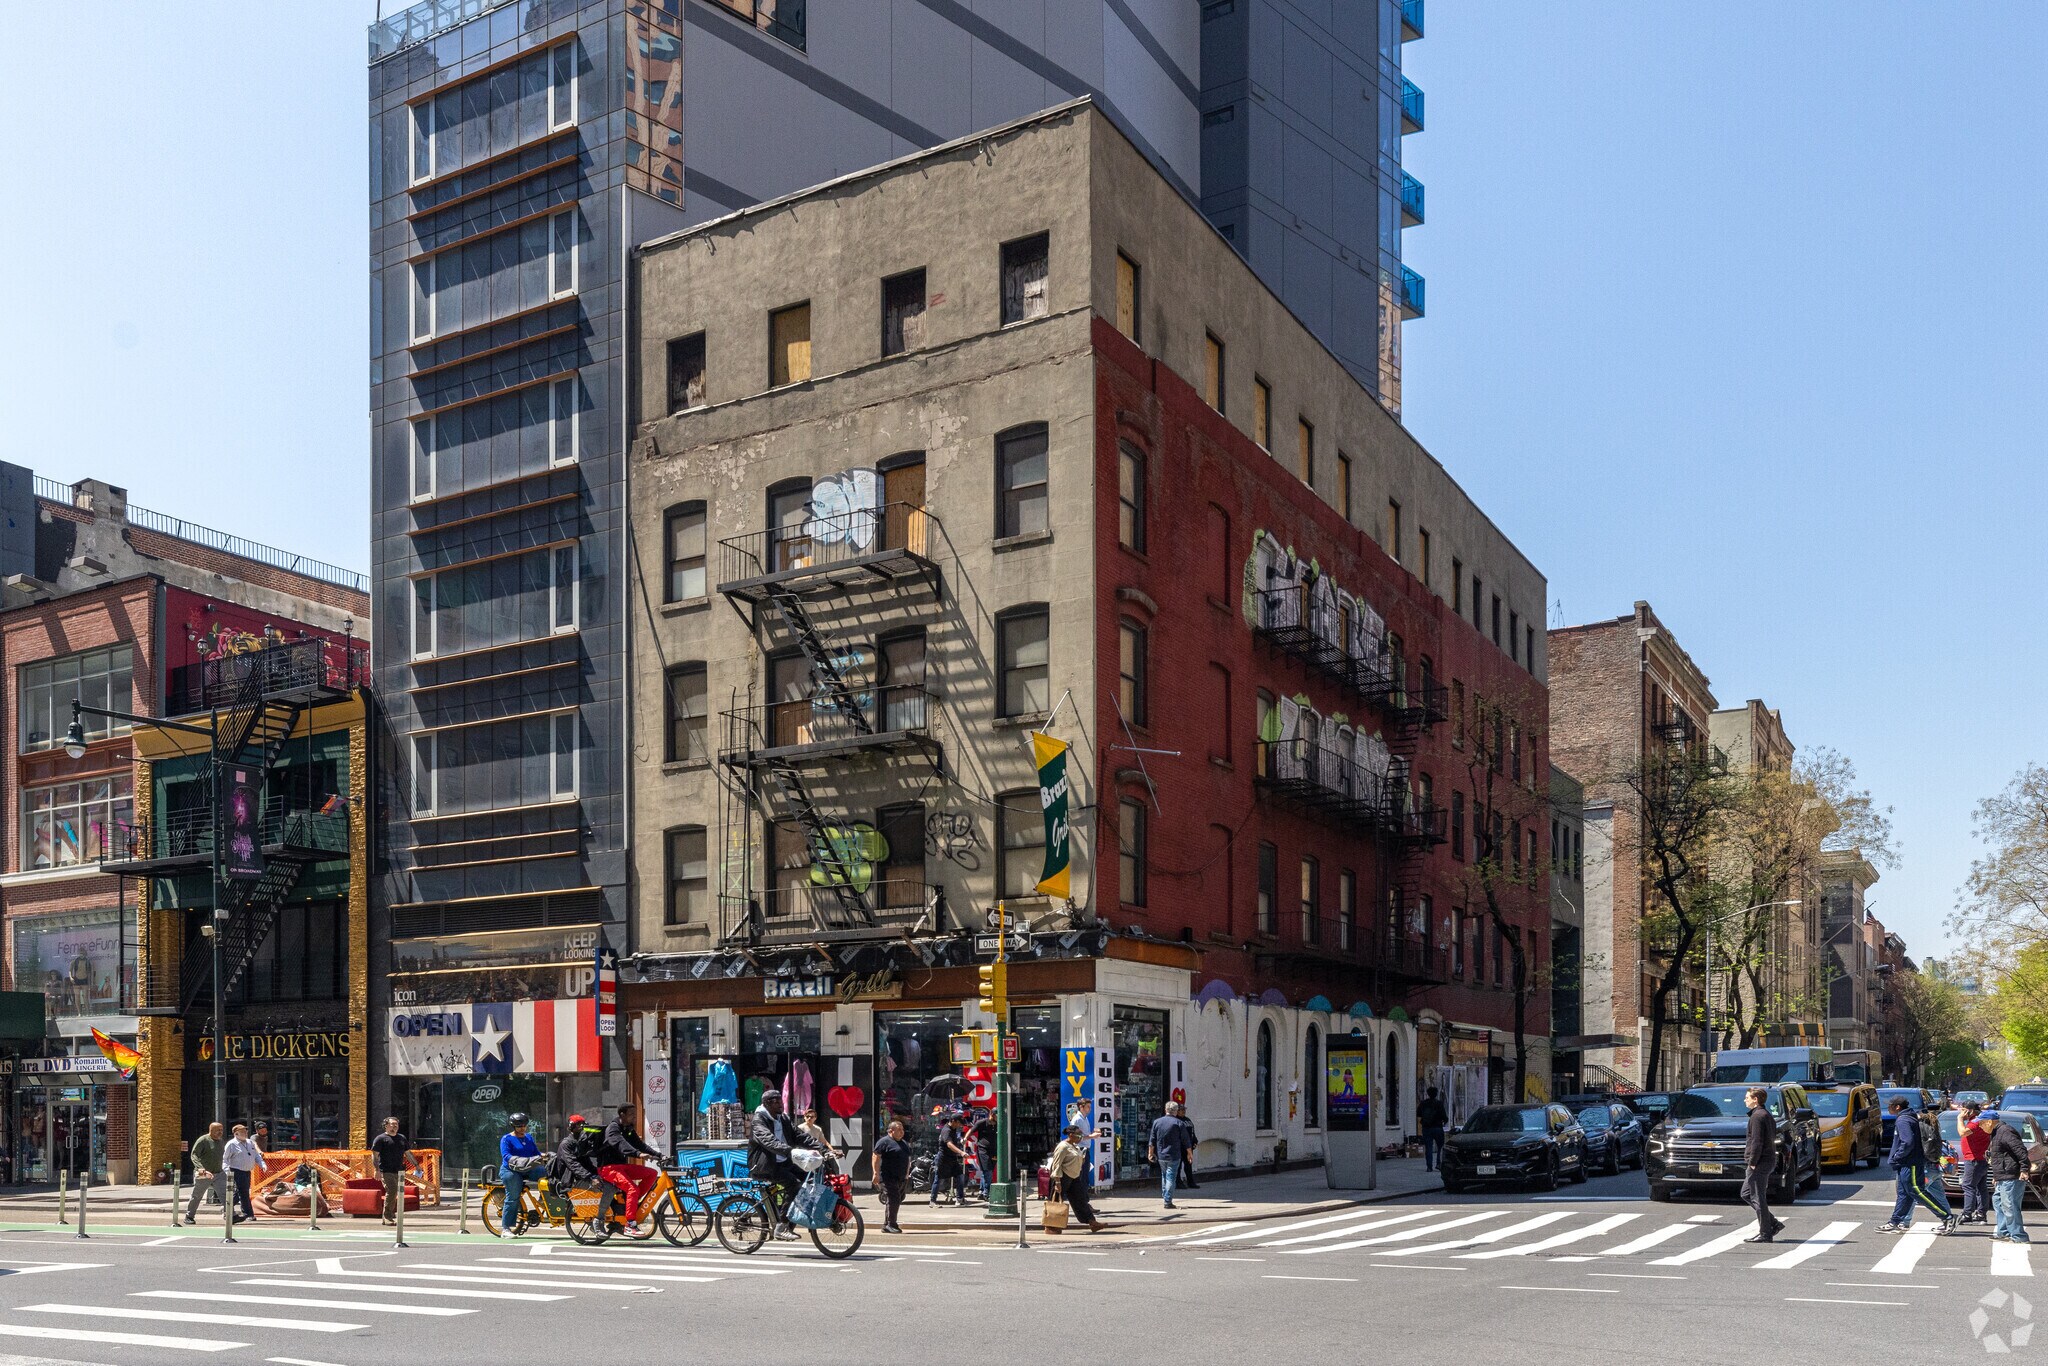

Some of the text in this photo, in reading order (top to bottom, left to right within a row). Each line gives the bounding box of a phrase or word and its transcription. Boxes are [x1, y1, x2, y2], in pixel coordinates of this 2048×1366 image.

[564, 931, 597, 949] KEEP
[983, 939, 1022, 948] ONE WAY
[564, 948, 596, 960] LOOKING
[565, 967, 596, 996] UP
[764, 969, 893, 1004] Brazil Grill
[394, 988, 417, 1002] icon
[393, 1013, 463, 1037] OPEN
[251, 1033, 350, 1058] DICKENS
[776, 1036, 799, 1046] OPEN
[44, 1058, 71, 1072] DVD
[838, 1057, 853, 1086] I
[1065, 1051, 1087, 1097] NY
[474, 1089, 498, 1099] OPEN
[1098, 1052, 1112, 1153] LUGGAGE
[640, 1191, 657, 1214] JOCO
